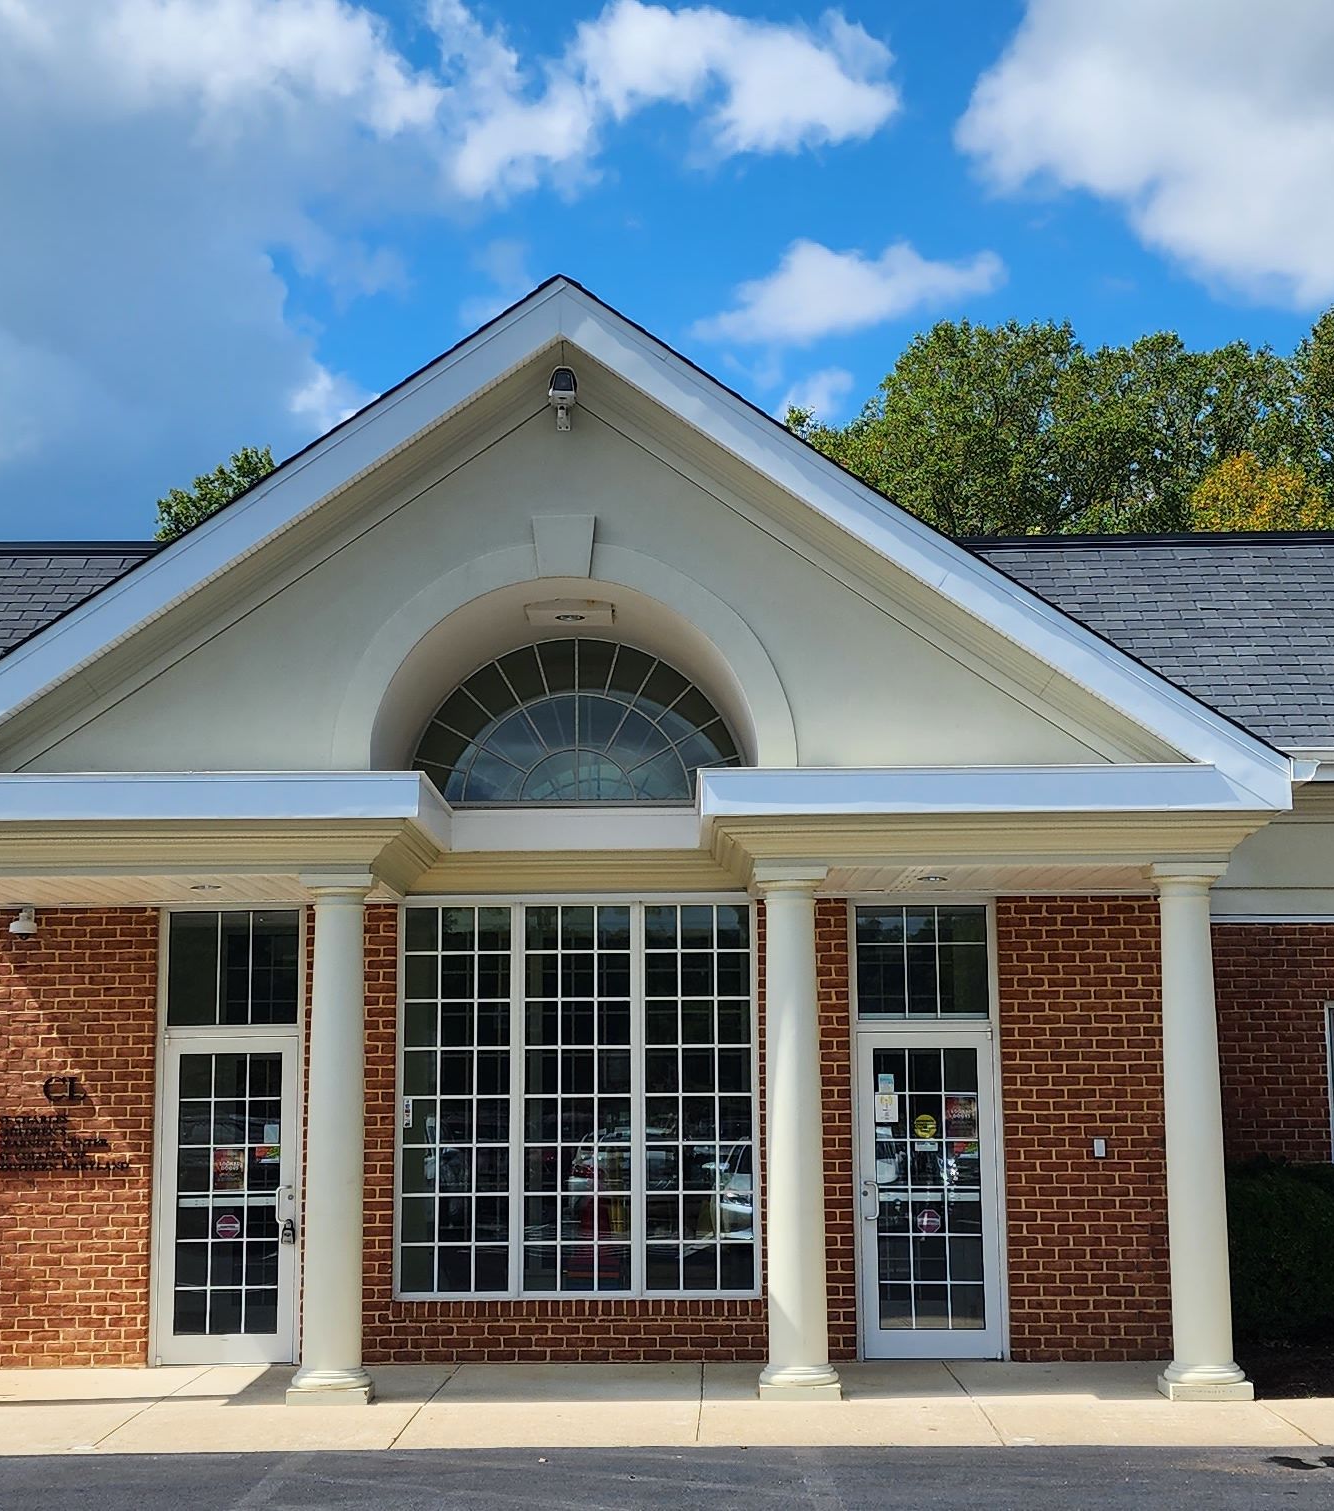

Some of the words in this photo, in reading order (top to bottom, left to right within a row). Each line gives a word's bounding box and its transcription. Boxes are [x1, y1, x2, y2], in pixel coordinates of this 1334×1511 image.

[43, 1076, 86, 1100] CL
[63, 1138, 108, 1147] CENTER
[15, 1151, 69, 1160] COLLEGE
[62, 1161, 130, 1171] MARYLAND
